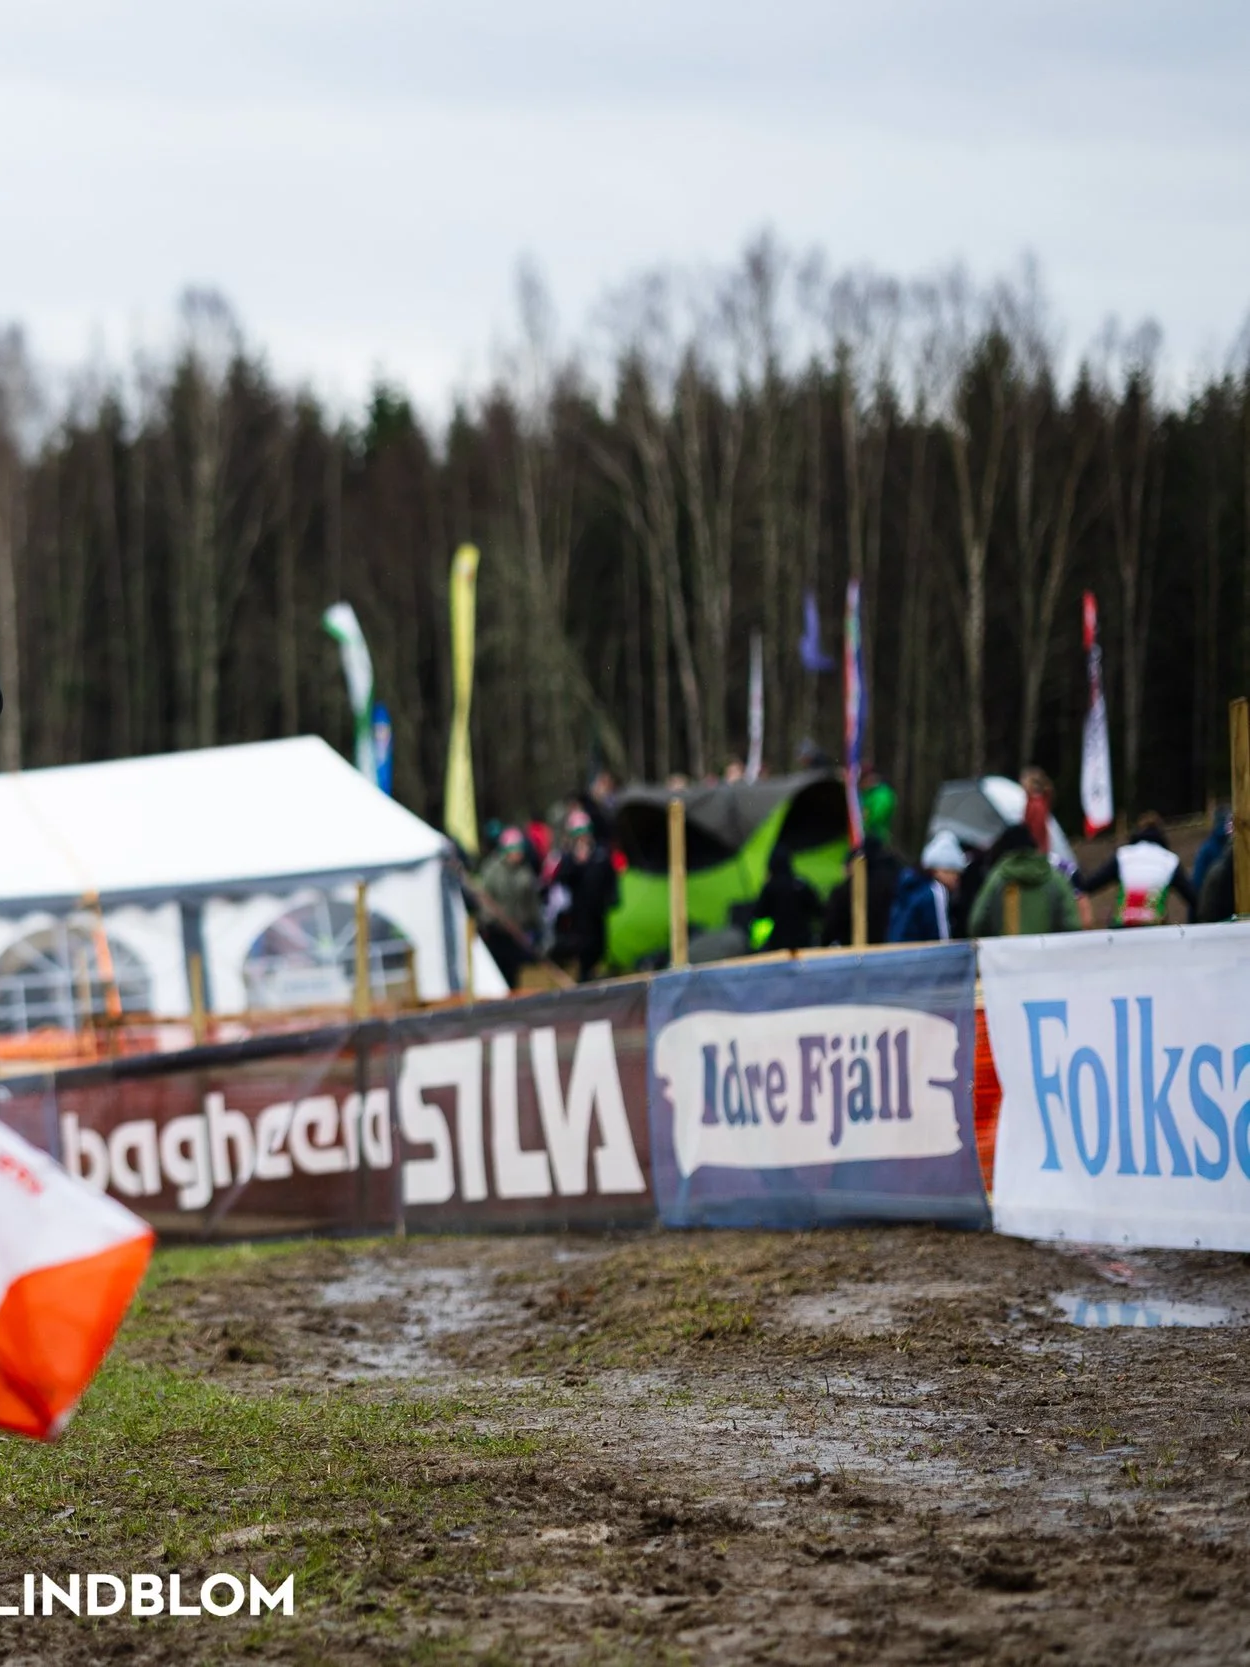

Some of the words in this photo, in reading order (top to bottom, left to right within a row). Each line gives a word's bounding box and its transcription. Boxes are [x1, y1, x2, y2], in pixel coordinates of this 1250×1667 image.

[61, 1088, 393, 1210] bagheera
[398, 1019, 647, 1206] SILVA
[700, 1038, 788, 1127] Idre
[798, 1028, 913, 1148] Fjäll
